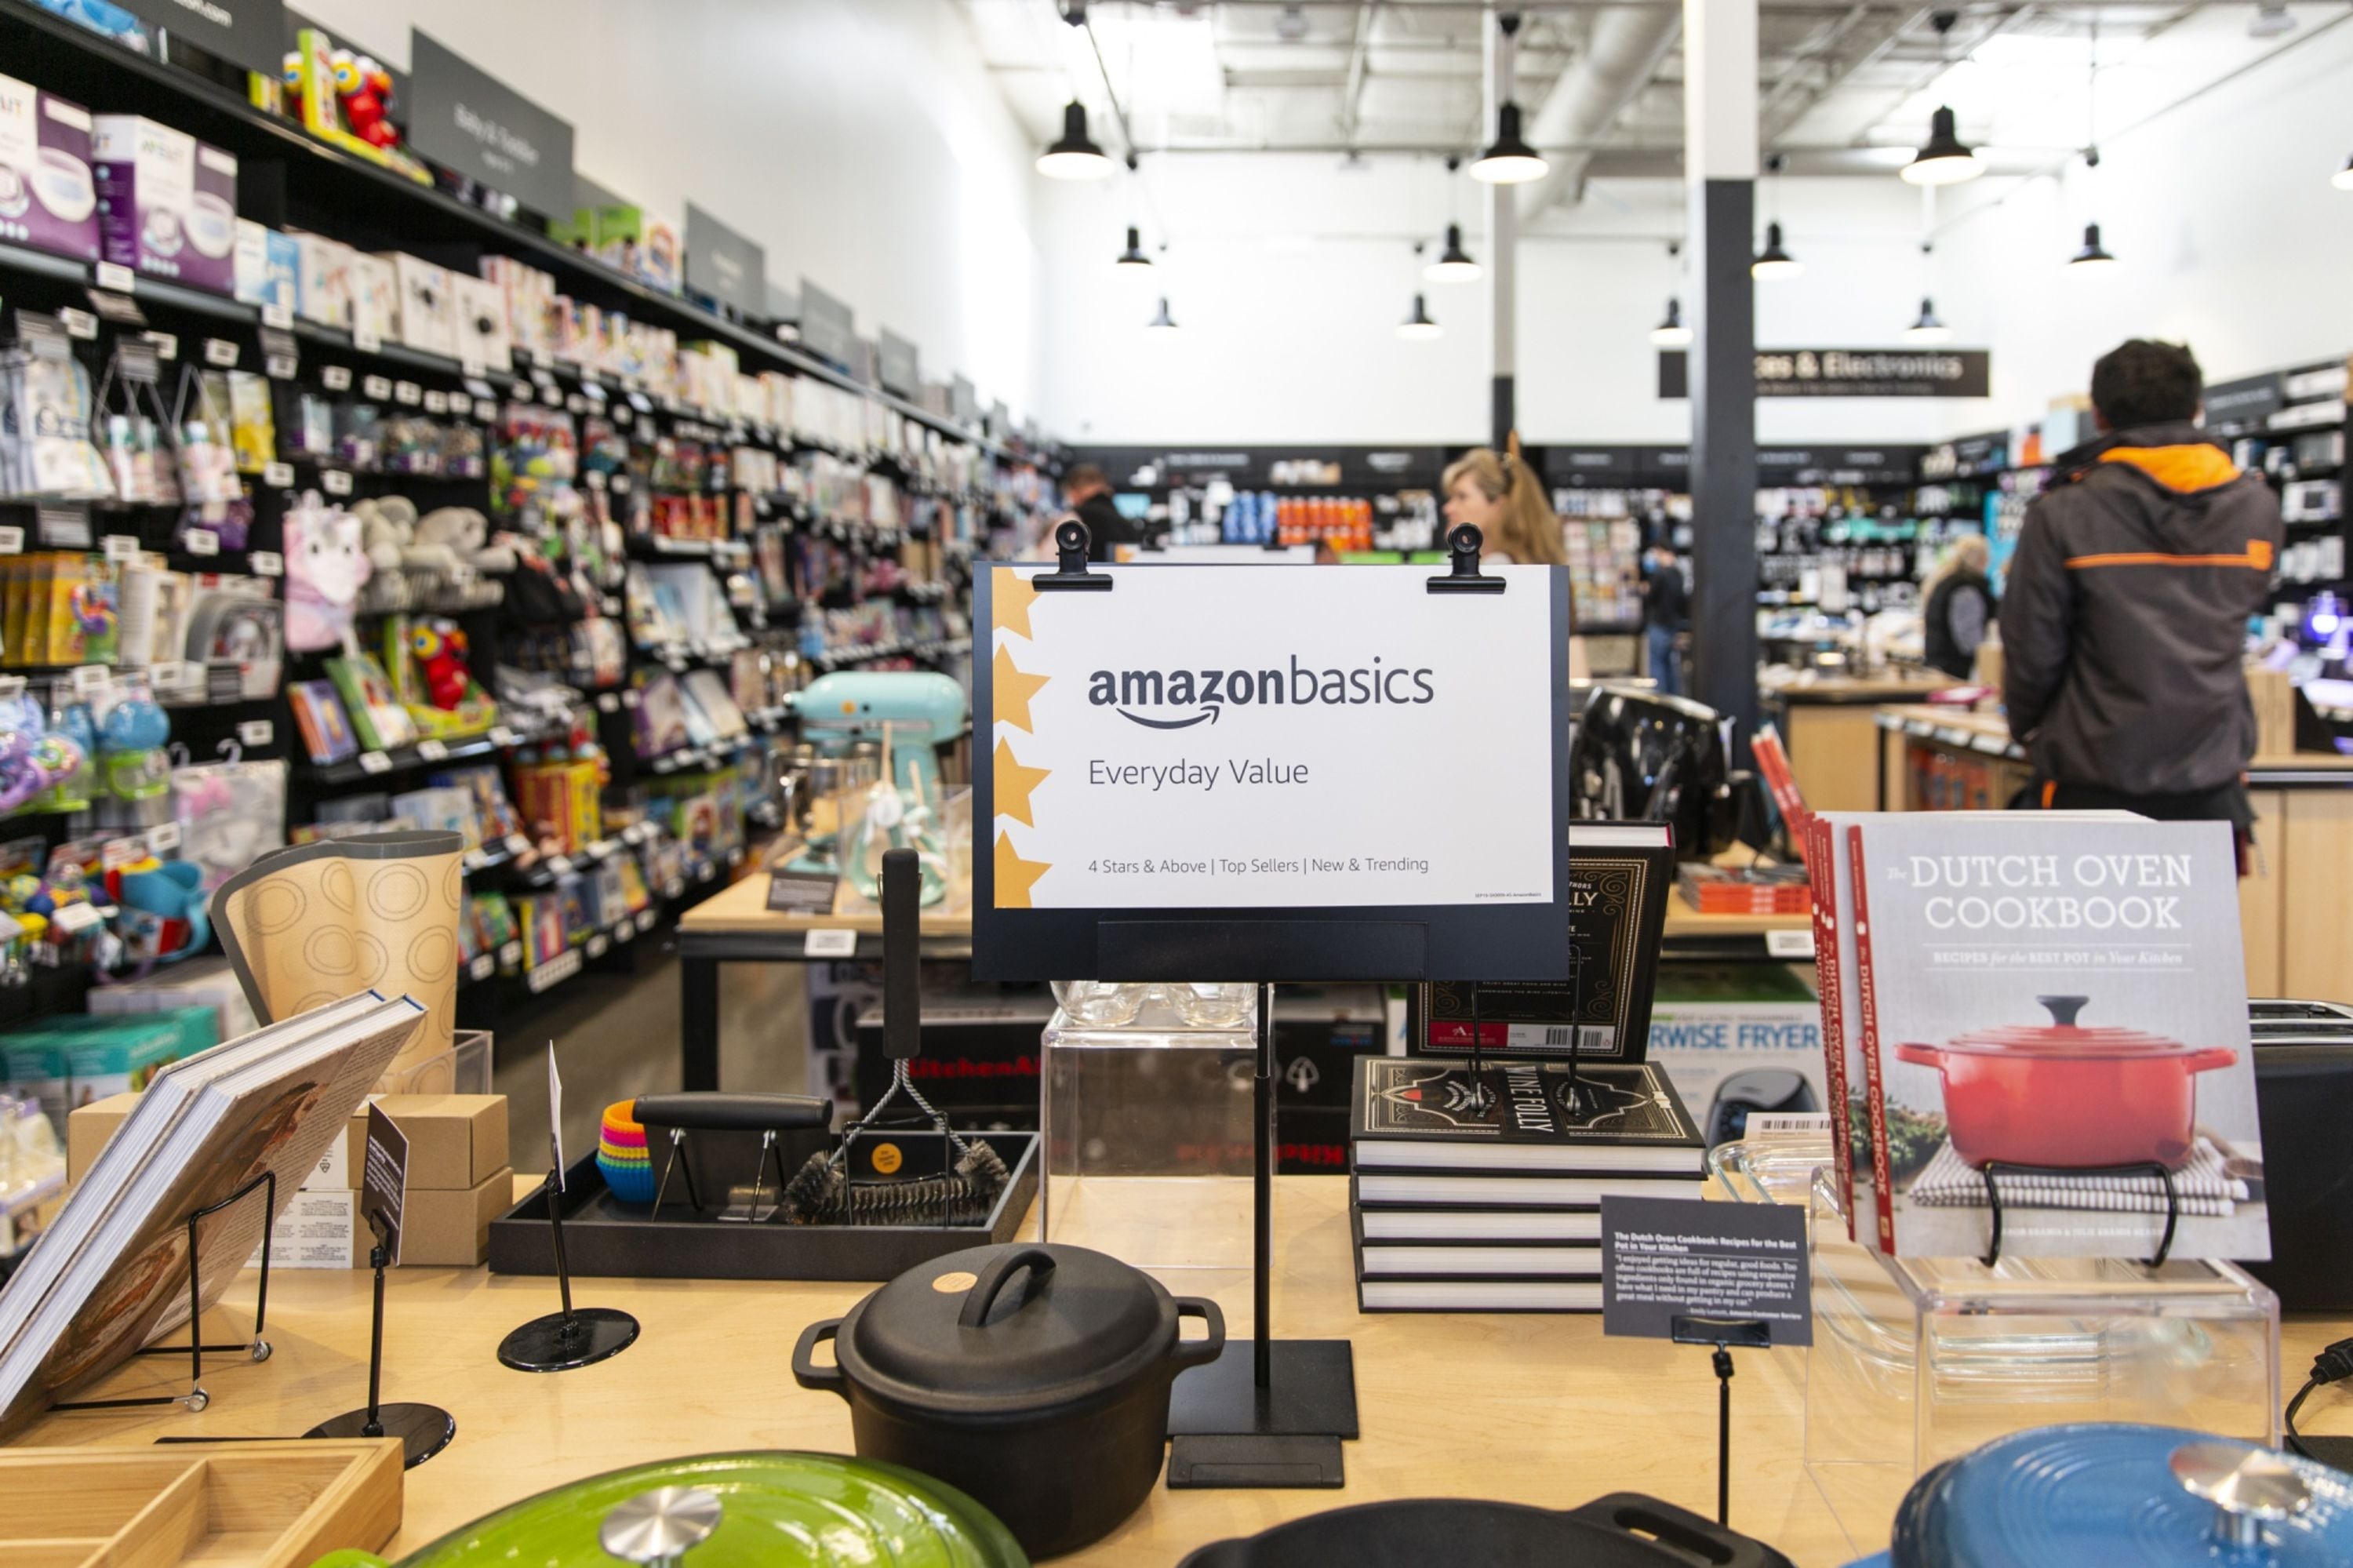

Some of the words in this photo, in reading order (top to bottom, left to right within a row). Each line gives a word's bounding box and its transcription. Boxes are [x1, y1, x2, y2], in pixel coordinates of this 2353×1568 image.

[1796, 351, 1819, 379] &
[1823, 351, 1963, 380] Electronics
[1089, 654, 1435, 708] amazonbasics
[1089, 759, 1220, 791] Everyday
[1229, 758, 1308, 784] Value
[1088, 861, 1098, 873] 4
[1102, 860, 1139, 874] Stars
[1143, 860, 1155, 873] &
[1160, 860, 1206, 873] Above
[1219, 860, 1247, 875] Top
[1251, 859, 1299, 872] Sellers
[1312, 859, 1344, 872] New
[1348, 859, 1361, 871] &
[1366, 858, 1429, 874] Trending
[1887, 867, 1907, 880] The
[1910, 856, 2060, 887] DUTCH
[2073, 854, 2192, 887] OVEN
[1569, 881, 1591, 890] THORS
[1925, 896, 2182, 929] COOKBOOK
[1933, 952, 1988, 964] RECIPES
[1990, 952, 2007, 966] for
[2009, 951, 2027, 964] the
[2028, 951, 2060, 963] BEST
[2064, 951, 2089, 963] POT
[2093, 951, 2106, 963] in
[2109, 951, 2136, 963] Your
[2137, 951, 2183, 963] Kitchen
[1827, 959, 1840, 1019] DUTCH
[1860, 965, 1873, 1026] DUTCH
[1649, 1024, 1728, 1049] RWISE
[1737, 1024, 1820, 1049] FRYER
[1831, 1024, 1843, 1072] OVEN
[1865, 1031, 1879, 1081] OVEN
[1505, 1065, 1543, 1097] WINE
[1512, 1097, 1555, 1133] FOLLY
[1870, 1086, 1887, 1196] COOKBOOK
[1614, 1231, 1629, 1241] The
[1631, 1232, 1654, 1242] Dutch
[1656, 1234, 1676, 1243] Oven
[1678, 1235, 1718, 1246] Cookbook:
[1720, 1237, 1750, 1249] Recipes
[1751, 1239, 1763, 1248] for
[1764, 1239, 1778, 1249] the
[1779, 1240, 1797, 1250] Best
[1614, 1242, 1628, 1250] Pot
[1659, 1243, 1689, 1253] Kitchen
[1615, 1263, 1635, 1271] often
[1636, 1264, 1674, 1274] cookbooks
[1687, 1266, 1700, 1275] full
[1702, 1267, 1710, 1275] of
[1711, 1269, 1736, 1278] recipes
[1737, 1270, 1758, 1280] using
[1623, 1255, 1651, 1264] enjoyed
[1652, 1257, 1678, 1267] getting
[1679, 1257, 1698, 1266] ideas
[1699, 1257, 1710, 1267] for
[1740, 1261, 1758, 1270] good
[1759, 1261, 1781, 1270] foods.
[1783, 1262, 1798, 1271] Too
[1616, 1273, 1657, 1282] ingredients
[1658, 1274, 1674, 1285] only
[1675, 1275, 1697, 1285] found
[1699, 1276, 1707, 1285] in
[1708, 1278, 1735, 1288] organic
[1736, 1280, 1764, 1290] grocery
[1766, 1280, 1788, 1290] stores.
[1635, 1282, 1653, 1292] what
[1658, 1284, 1677, 1293] need
[1678, 1285, 1686, 1293] in
[1686, 1286, 1699, 1297] my
[1700, 1287, 1725, 1297] pantry
[1726, 1288, 1740, 1297] and
[1755, 1290, 1786, 1299] produce
[1616, 1293, 1635, 1302] great
[1636, 1293, 1655, 1301] meal
[1655, 1293, 1685, 1302] without
[1686, 1296, 1713, 1306] getting
[1722, 1298, 1734, 1307] my
